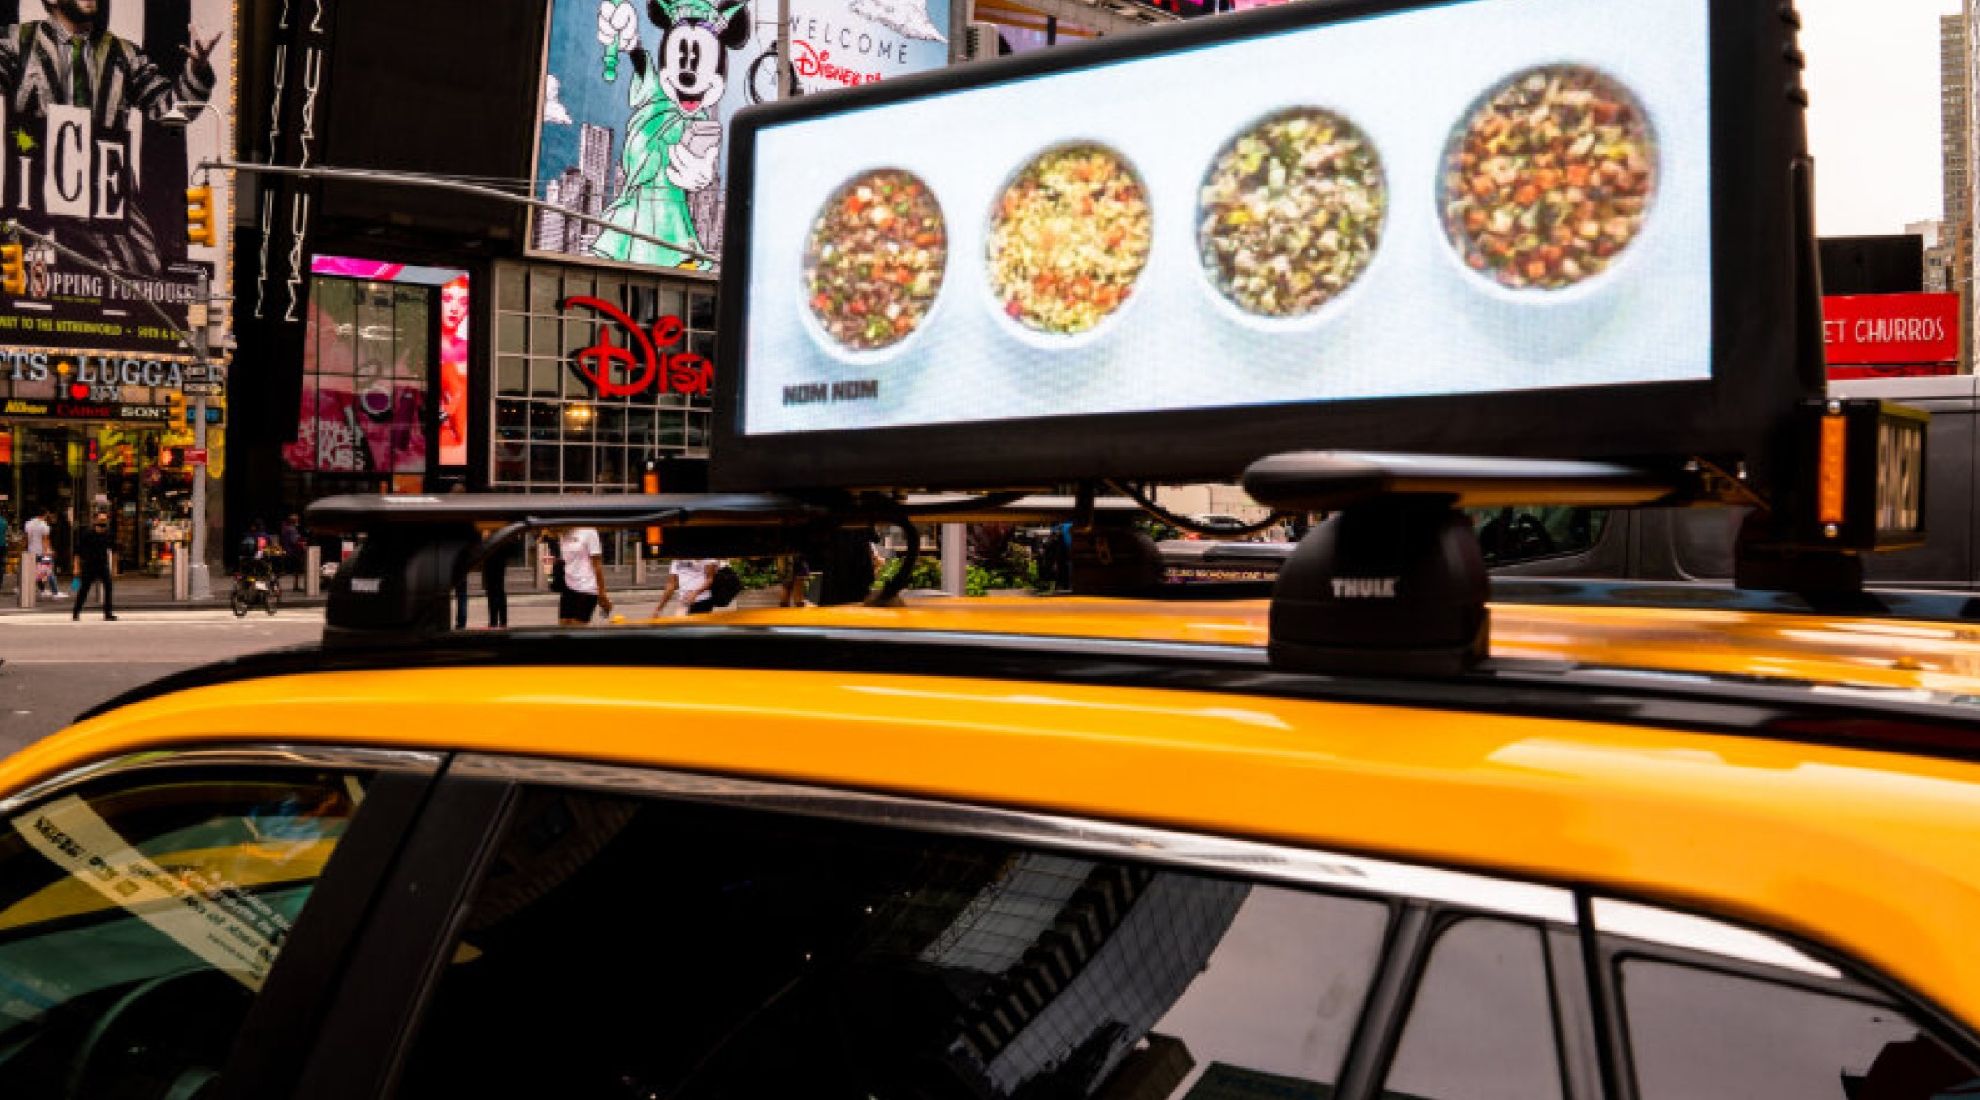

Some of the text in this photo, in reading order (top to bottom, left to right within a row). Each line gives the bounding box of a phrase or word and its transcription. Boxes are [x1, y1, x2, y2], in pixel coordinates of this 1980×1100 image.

[1855, 316, 1945, 343] CHURROS
[77, 355, 223, 387] LUGGAE
[782, 380, 878, 405] NOM NOM
[1331, 578, 1396, 597] THULE
